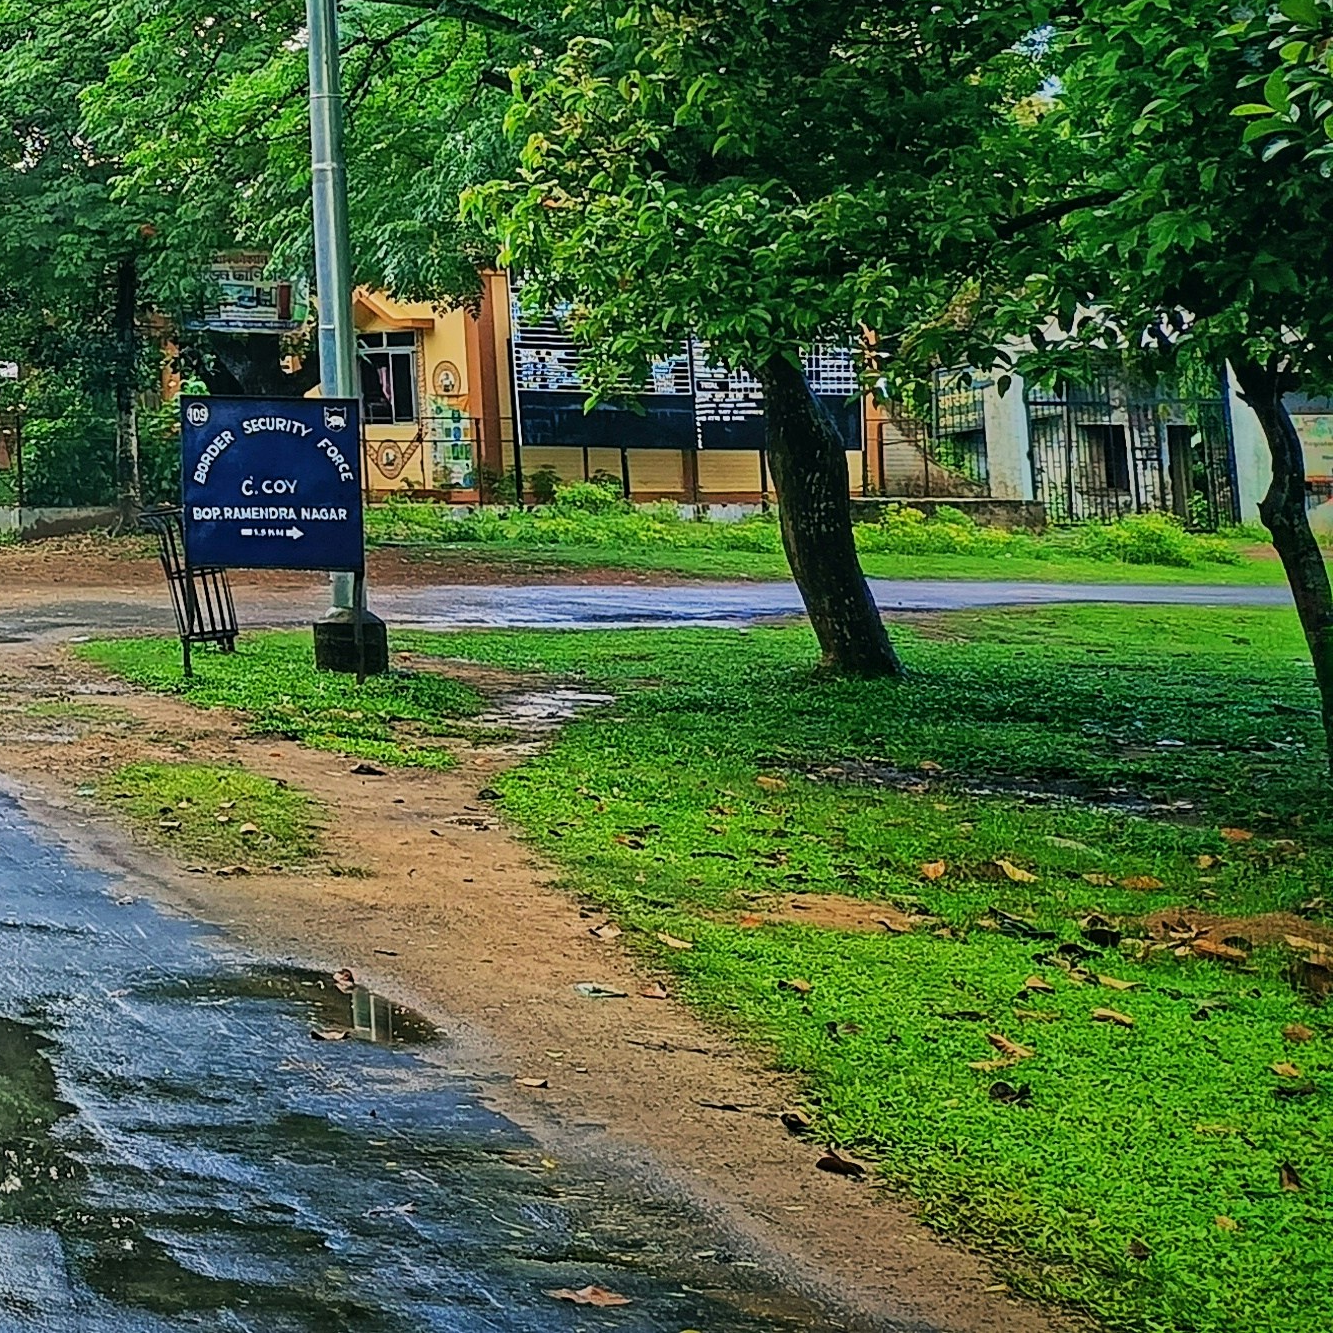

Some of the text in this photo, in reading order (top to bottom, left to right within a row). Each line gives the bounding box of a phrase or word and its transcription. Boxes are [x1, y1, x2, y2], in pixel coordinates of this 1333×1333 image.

[194, 417, 354, 484] BORDER SECURITY FORCE
[301, 508, 347, 521] NAGAR
